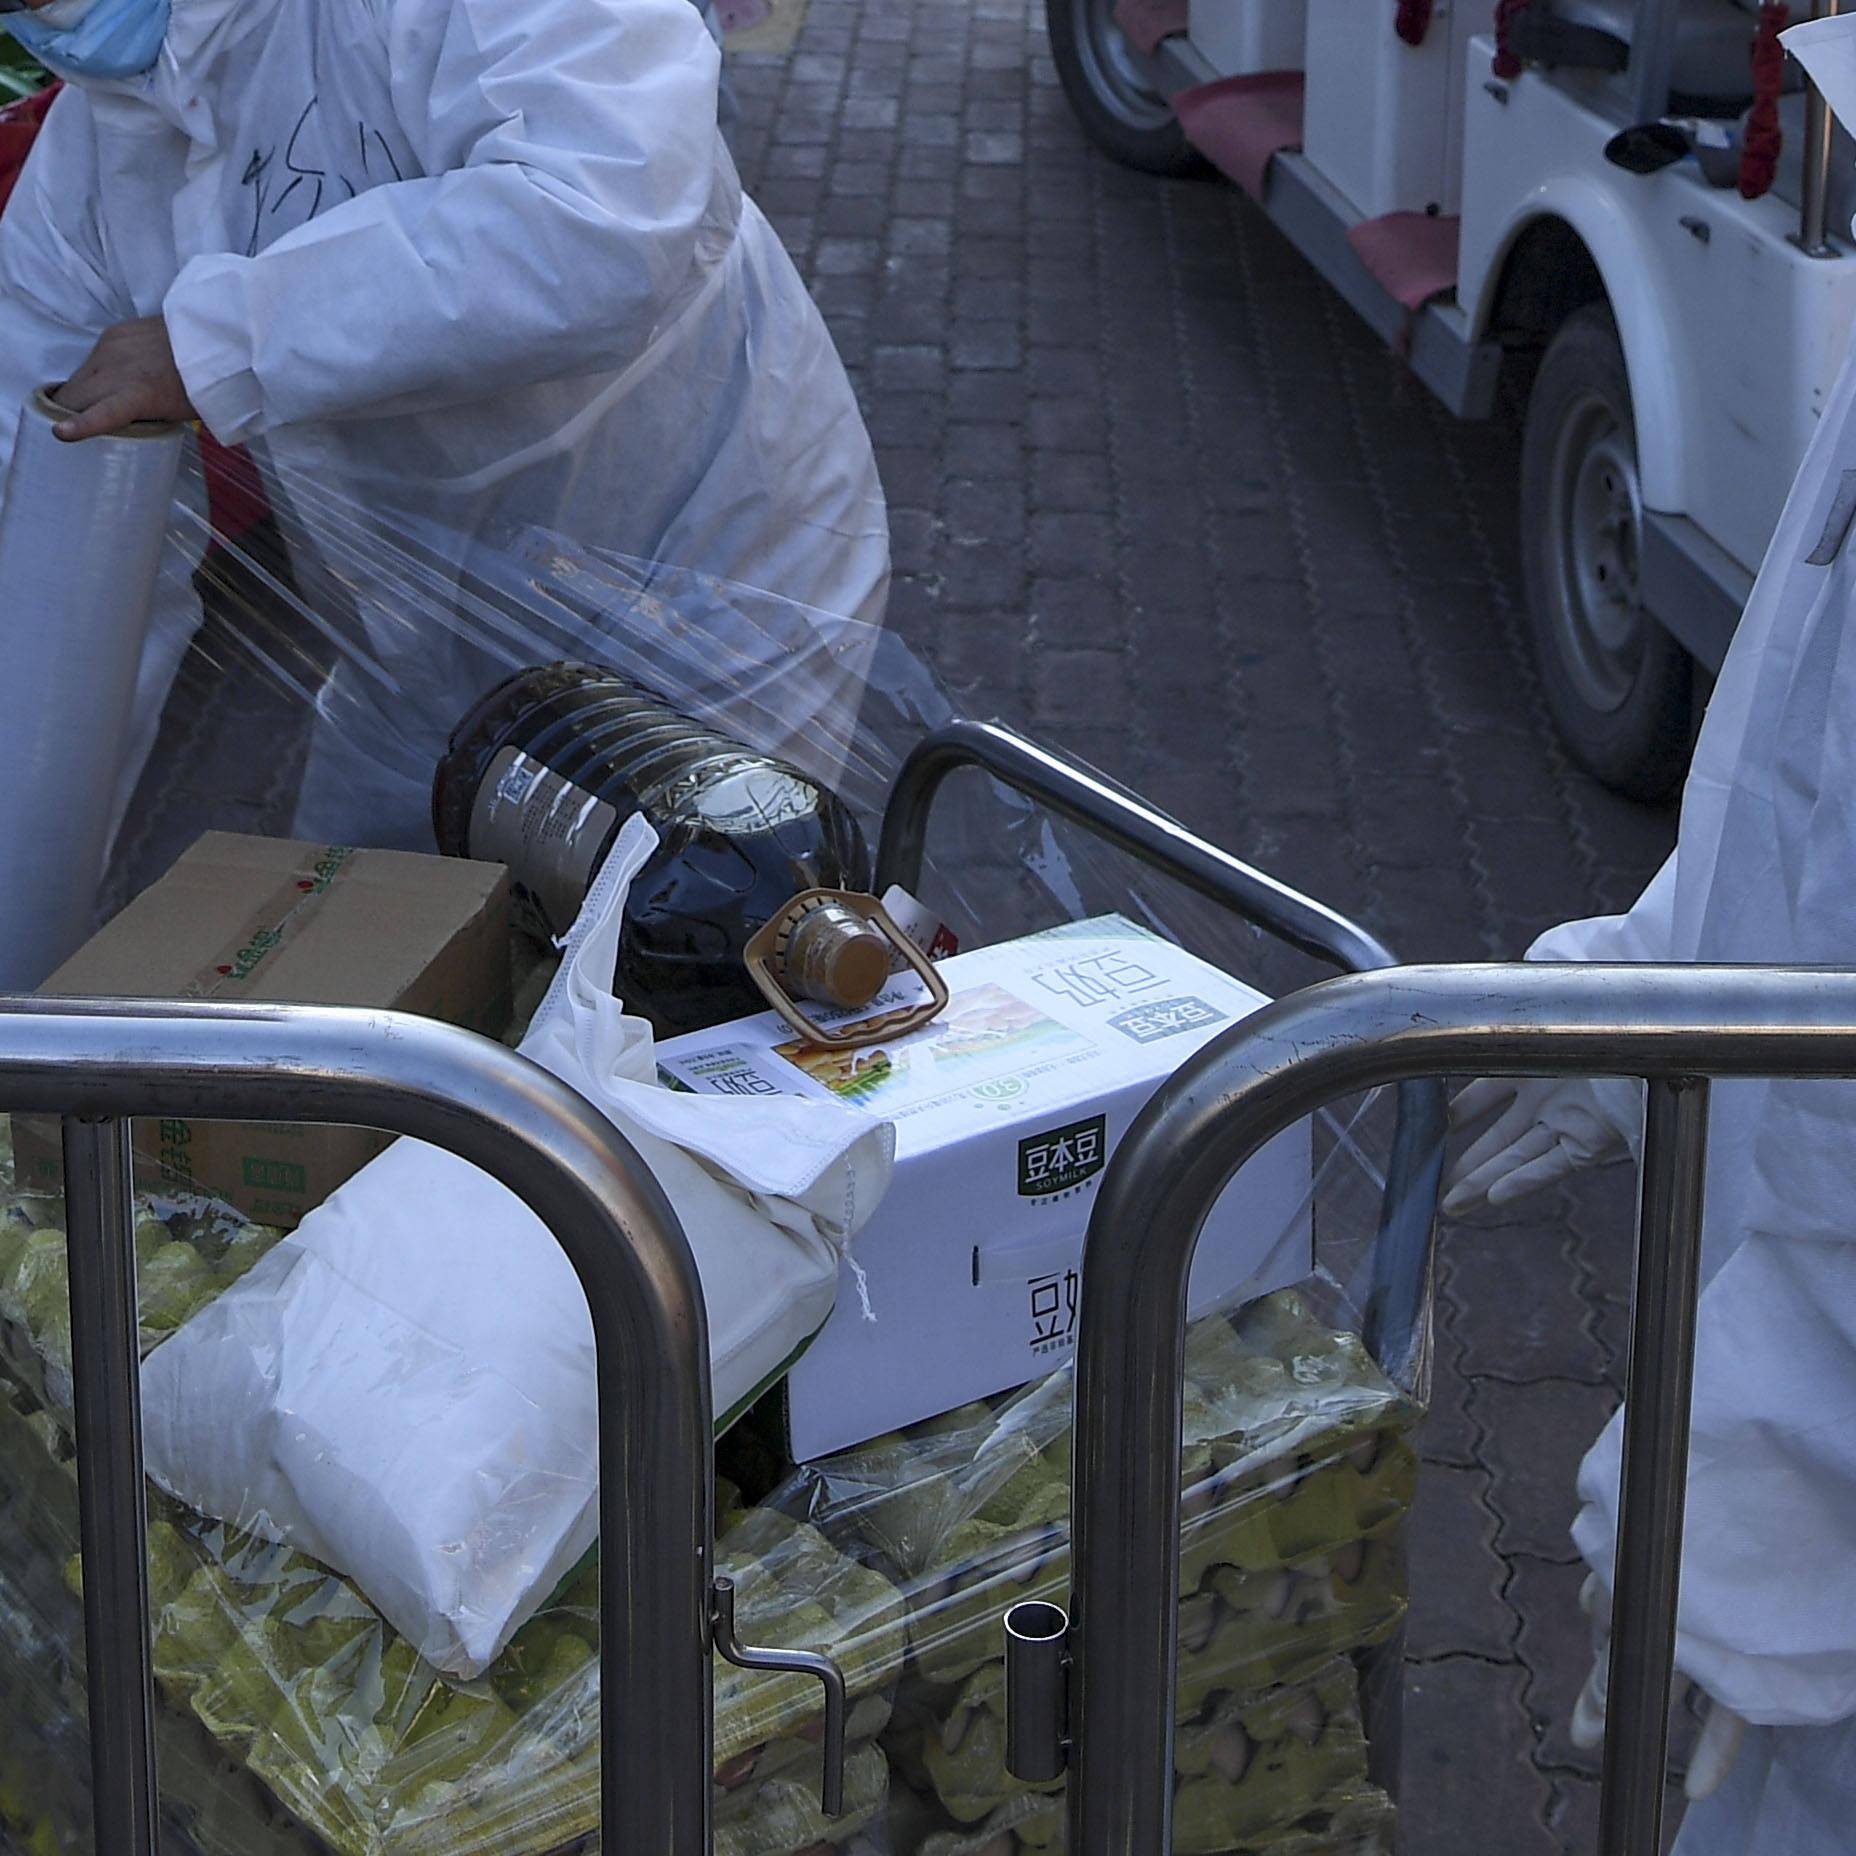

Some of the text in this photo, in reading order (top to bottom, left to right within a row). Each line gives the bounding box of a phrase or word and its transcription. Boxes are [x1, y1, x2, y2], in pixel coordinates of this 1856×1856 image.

[1024, 1127, 1099, 1184] 豆本豆
[1034, 1167, 1088, 1190] SOYMILK
